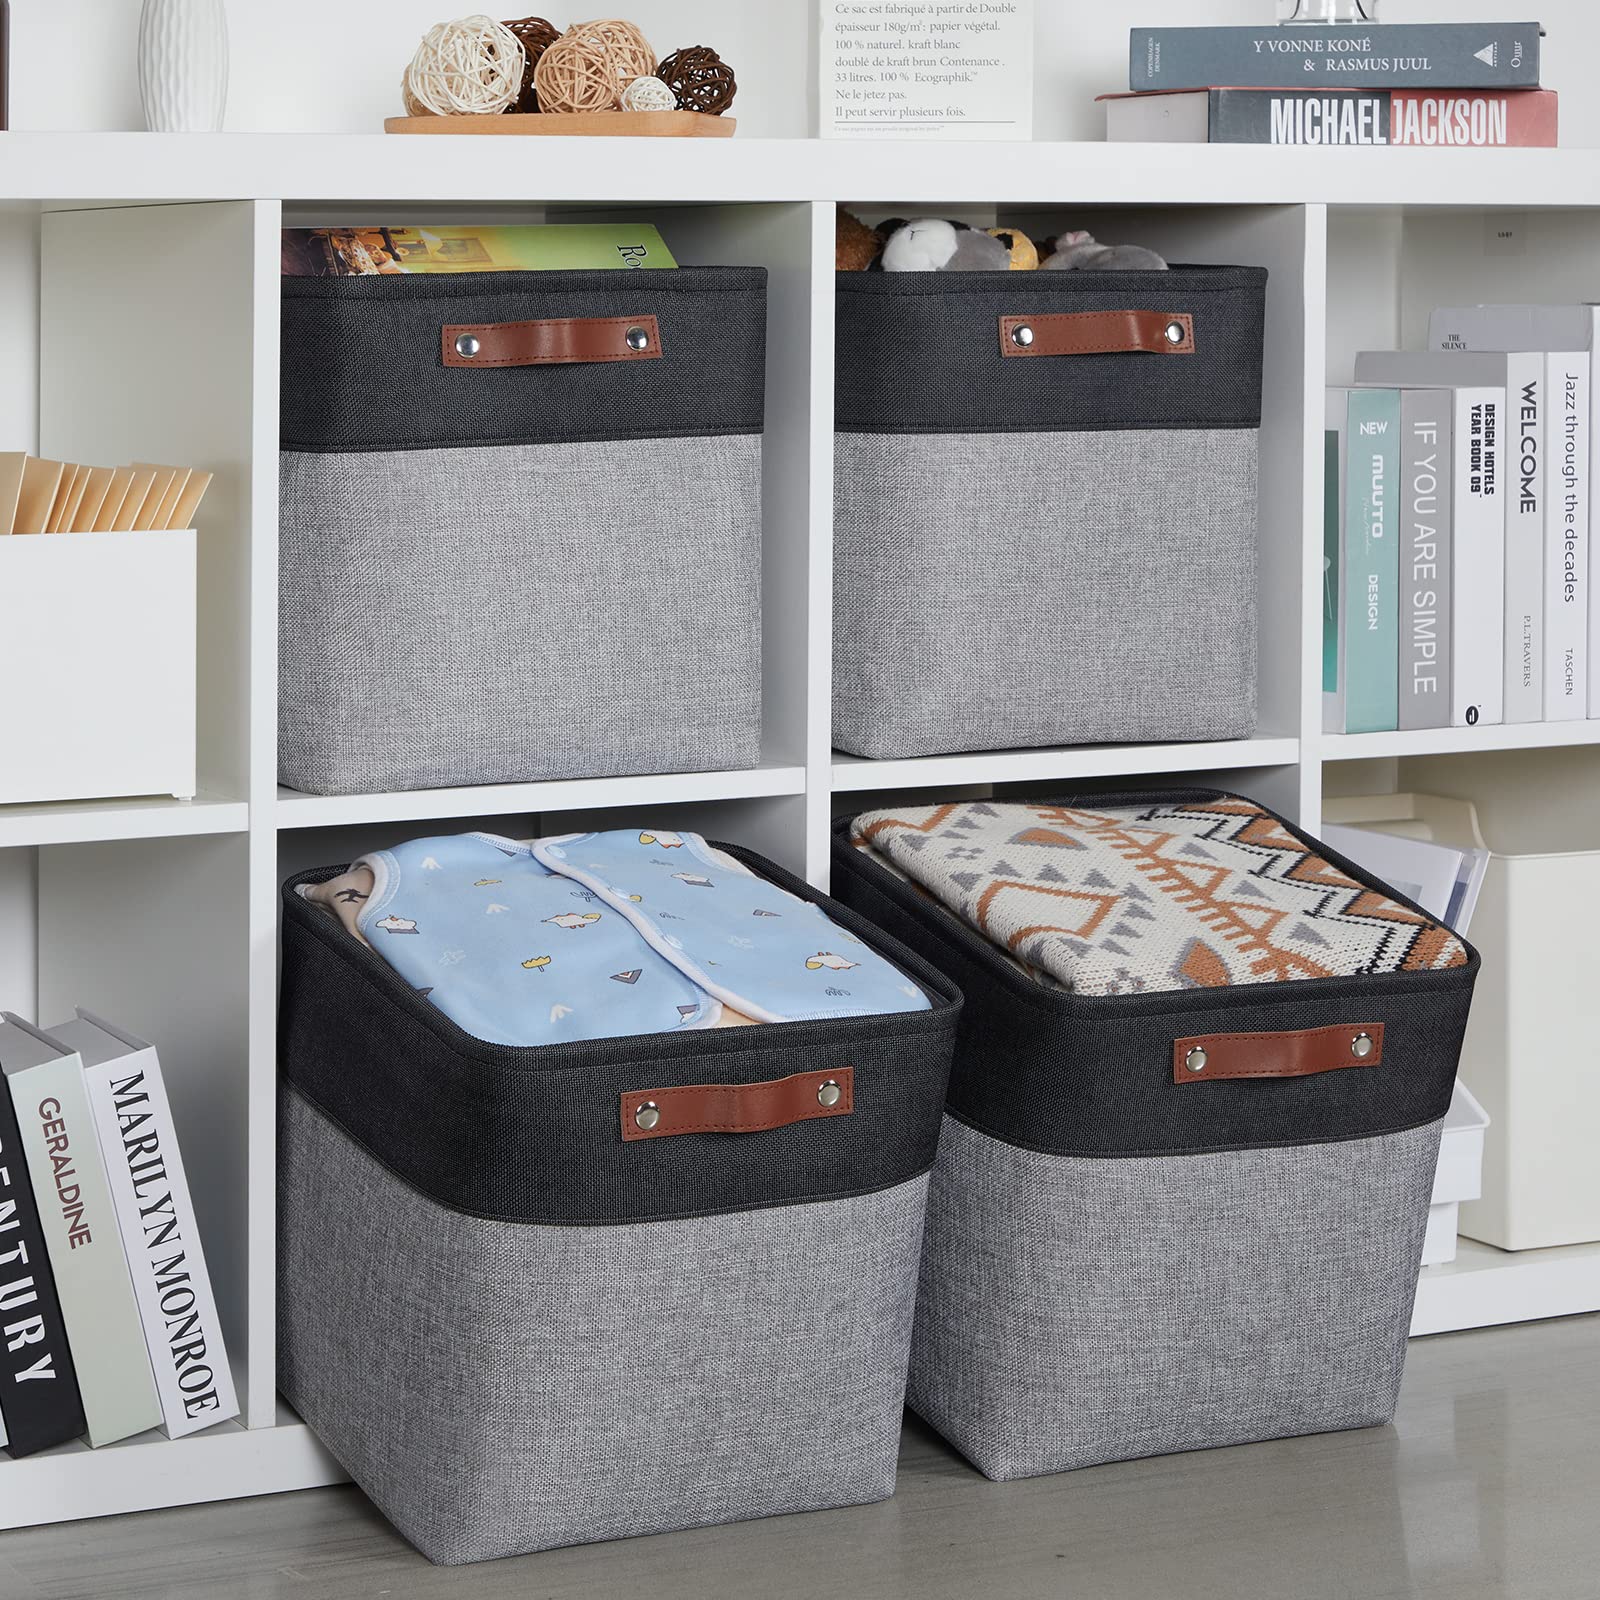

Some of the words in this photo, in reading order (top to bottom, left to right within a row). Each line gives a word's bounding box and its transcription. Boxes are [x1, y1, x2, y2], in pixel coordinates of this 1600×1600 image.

[835, 4, 849, 14] Ce
[852, 6, 867, 14] sac
[869, 5, 882, 14] est
[885, 3, 925, 16] fabriqué
[928, 4, 933, 13] à
[936, 4, 963, 16] partir
[966, 4, 978, 13] de
[979, 3, 1016, 13] Double
[835, 23, 880, 33] épaisseur
[930, 22, 961, 33] papier
[964, 20, 1000, 33] végétal.
[835, 40, 852, 49] 100
[855, 41, 864, 49] %
[908, 39, 931, 49] kraft
[934, 39, 960, 49] blanc
[1327, 37, 1371, 53] KONÉ
[835, 57, 869, 67] doublé
[872, 57, 884, 66] de
[887, 57, 910, 66] kraft
[912, 57, 936, 66] brun
[940, 57, 999, 66] Contenance
[835, 73, 847, 82] 33
[880, 72, 897, 81] 100
[900, 73, 909, 81] %
[1303, 58, 1316, 71] &
[1326, 58, 1390, 71] RASMUS
[1392, 57, 1431, 72] JUUL
[836, 89, 850, 99] Ne
[853, 89, 861, 99] le
[863, 90, 885, 101] jetez
[888, 92, 907, 101] pas.
[835, 107, 842, 116] Il
[846, 108, 866, 119] peut
[870, 107, 896, 116] servir
[900, 107, 943, 119] plusieurs
[946, 106, 966, 116] fois.
[1270, 98, 1386, 145] MICHAEL
[1392, 98, 1507, 145] JACKSON
[1442, 342, 1467, 350] SILENCE
[1565, 372, 1579, 410] Jazz
[1360, 422, 1388, 435] NEW
[1414, 421, 1436, 444] IF
[1471, 404, 1482, 434] YEAR
[1484, 404, 1495, 446] DESIGN
[1471, 439, 1481, 472] BOOK
[1520, 381, 1537, 514] WELCOME
[1562, 415, 1579, 488] through
[1414, 453, 1436, 514] YOU
[1484, 451, 1494, 494] HOTELS
[1565, 494, 1579, 523] the
[1413, 523, 1436, 580] ARE
[1564, 528, 1578, 602] decades
[1368, 574, 1378, 630] DESIGN
[1413, 591, 1436, 694] SIMPLE
[1565, 648, 1573, 696] TASCHEN
[39, 1097, 92, 1250] GERALDINE
[109, 1070, 181, 1249] MARILYN
[151, 1250, 220, 1419] MONROE
